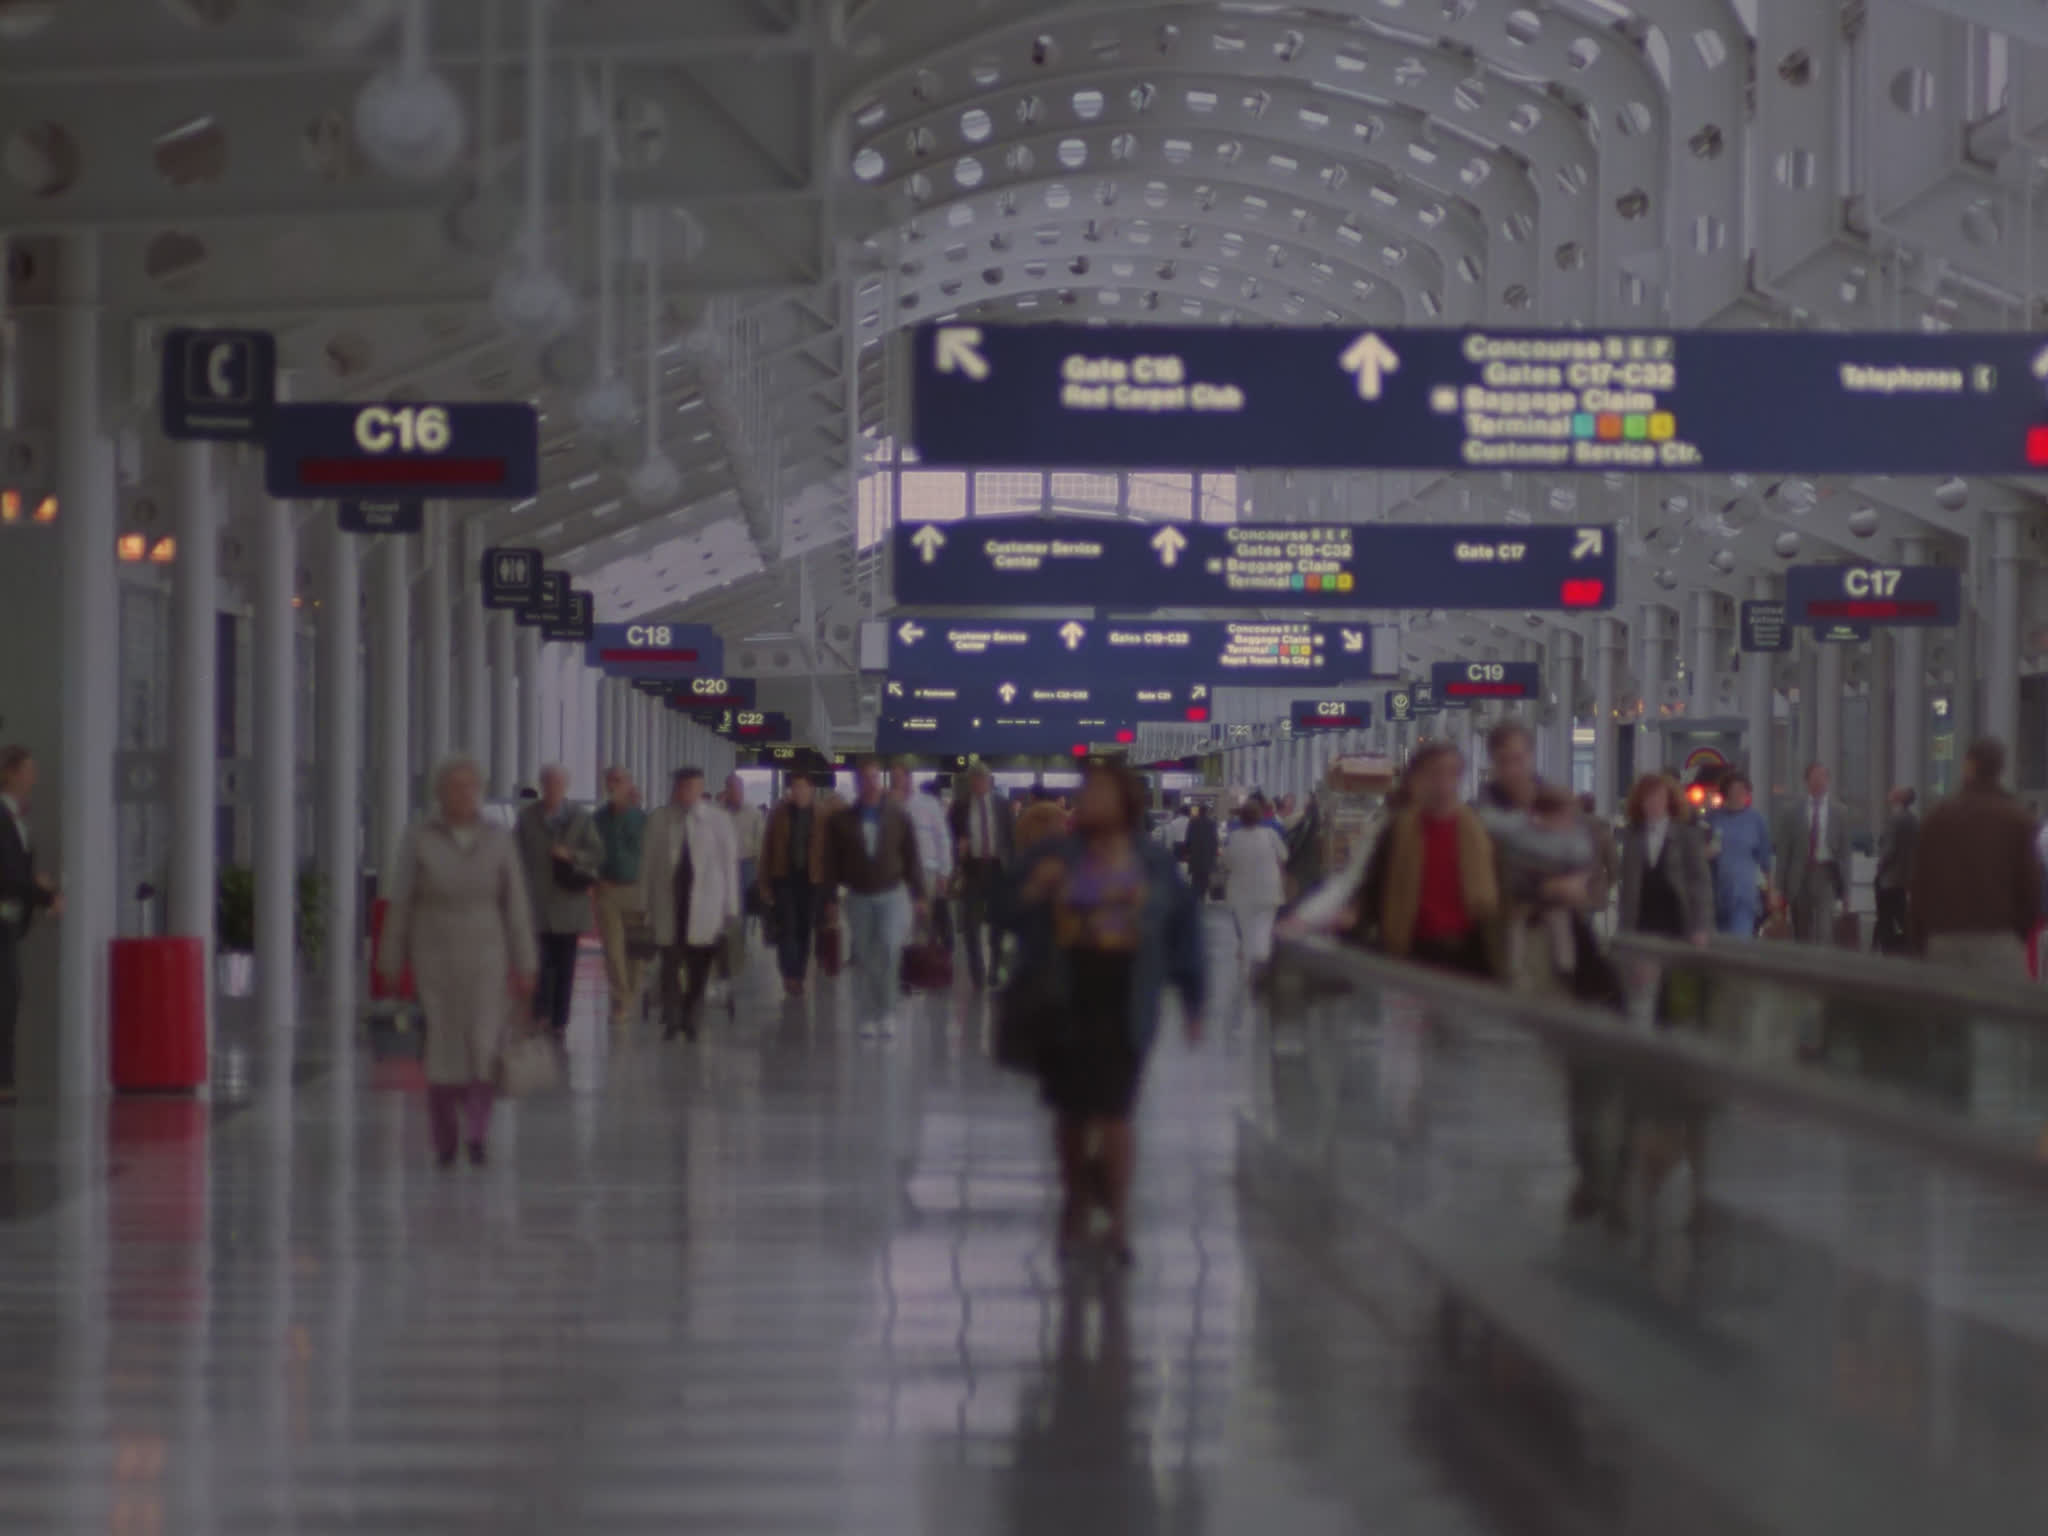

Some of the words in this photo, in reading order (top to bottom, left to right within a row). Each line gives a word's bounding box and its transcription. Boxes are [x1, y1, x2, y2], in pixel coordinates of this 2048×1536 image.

[1465, 335, 1601, 361] Concourse
[1063, 355, 1127, 380] Gate
[1484, 361, 1562, 386] Gates
[1841, 363, 1963, 394] Telephones
[1191, 383, 1243, 409] Club
[1464, 388, 1576, 414] Baggage
[1582, 389, 1656, 412] Claim
[354, 406, 451, 454] C16
[1465, 413, 1571, 438] Terminal
[1463, 440, 1569, 463] Customer
[1574, 441, 1656, 463] Service
[1227, 528, 1309, 542] Concourse
[985, 540, 1048, 555] Customer
[1052, 540, 1102, 557] Service
[1236, 543, 1281, 558] Gates
[1456, 543, 1495, 560] Gate
[1497, 543, 1526, 560] C17
[994, 555, 1040, 569] Center
[1226, 559, 1293, 574] Baggage
[1297, 559, 1340, 573] Claim
[1226, 574, 1291, 589] Terminal
[1844, 567, 1902, 597] C17
[626, 626, 671, 646] C18
[1467, 663, 1505, 682] C19
[691, 679, 728, 695] C20
[1317, 701, 1346, 716] C21
[736, 713, 764, 726] C22
